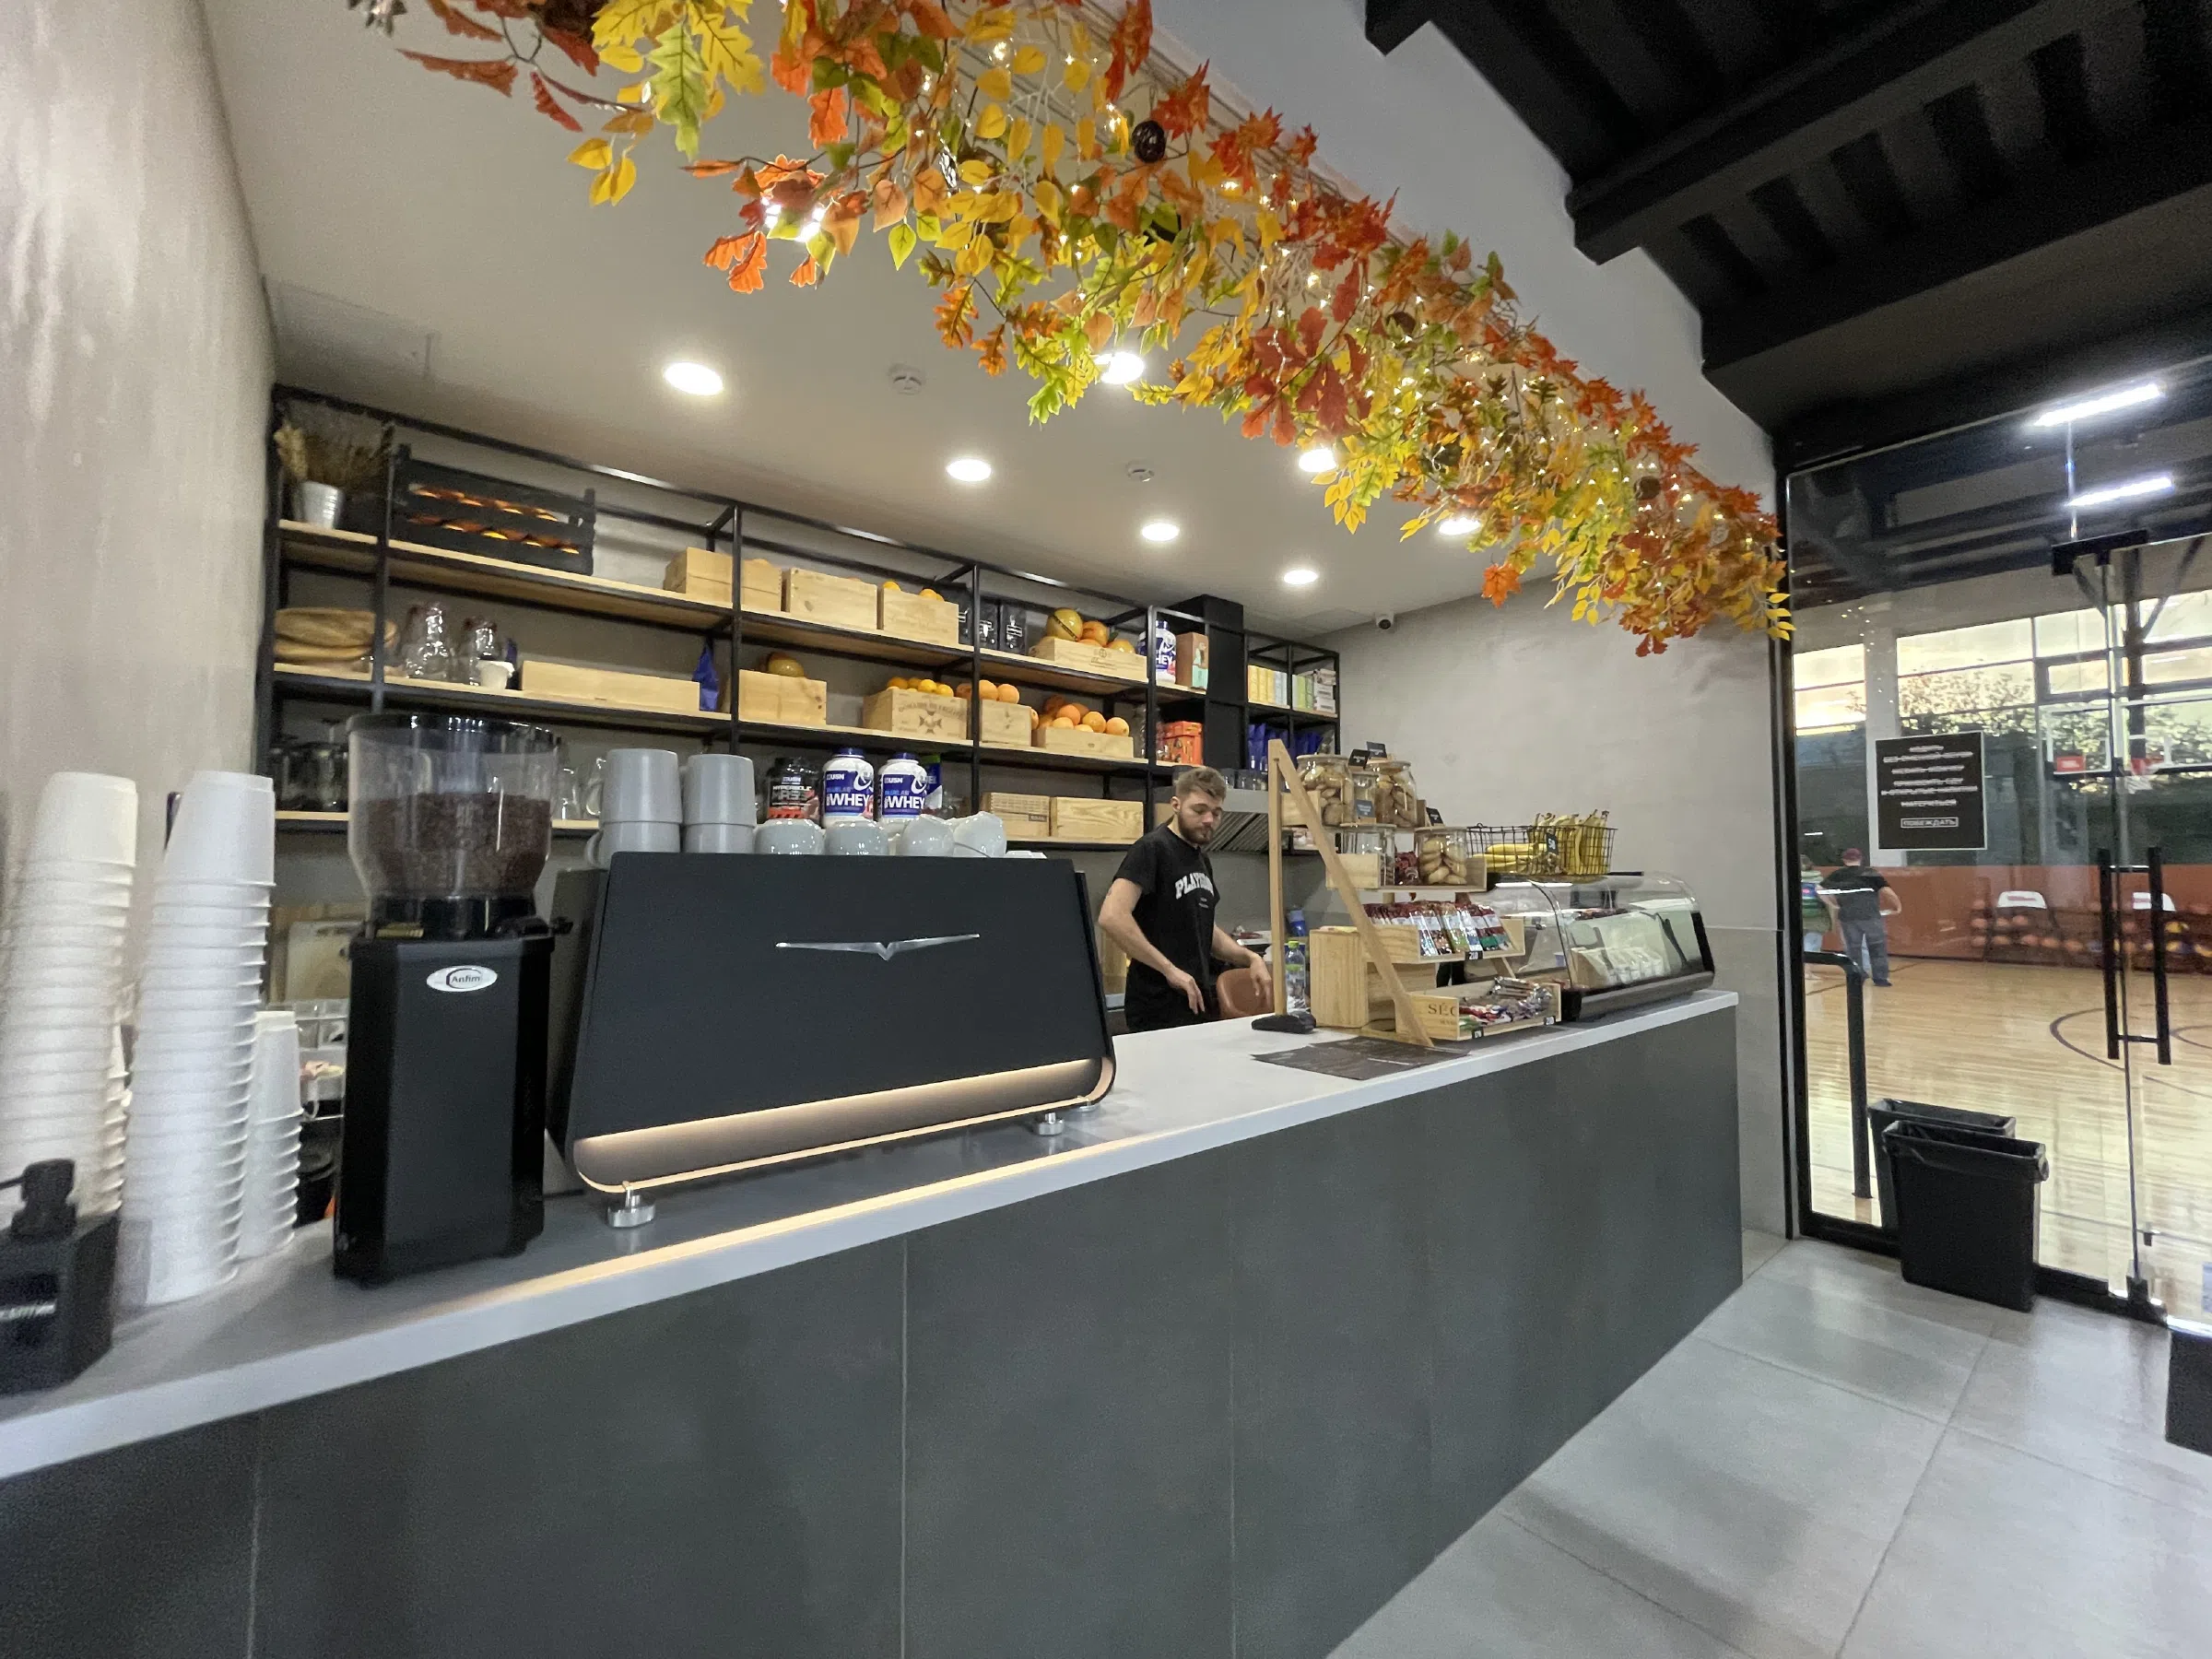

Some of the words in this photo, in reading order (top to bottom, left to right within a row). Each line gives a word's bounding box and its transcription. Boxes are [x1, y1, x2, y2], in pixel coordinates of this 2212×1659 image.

[830, 793, 870, 806] WHEY
[888, 795, 925, 810] WHEY
[451, 974, 480, 983] Anfim
